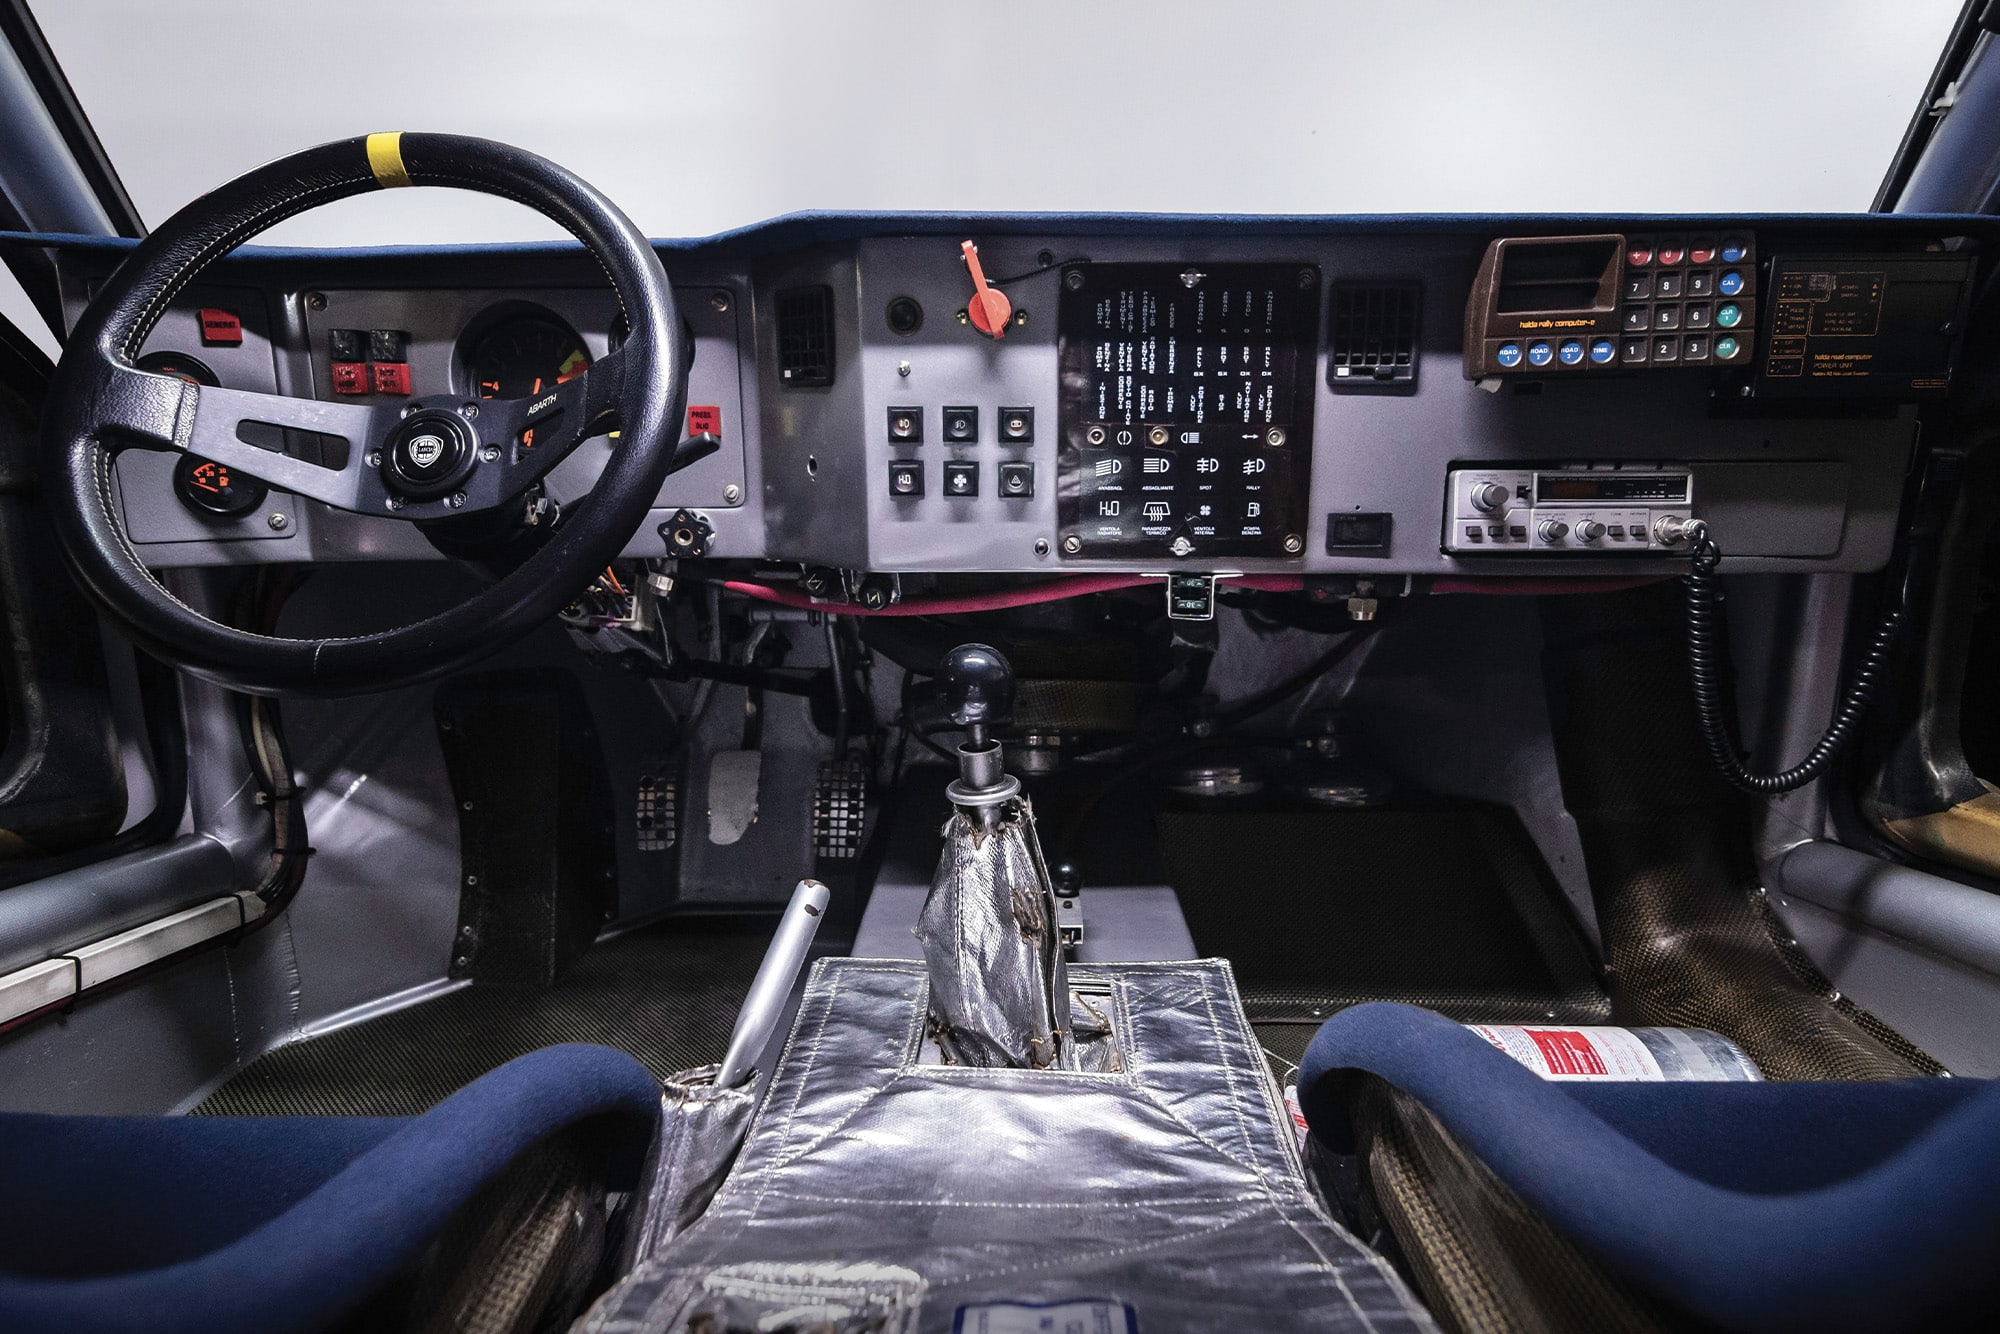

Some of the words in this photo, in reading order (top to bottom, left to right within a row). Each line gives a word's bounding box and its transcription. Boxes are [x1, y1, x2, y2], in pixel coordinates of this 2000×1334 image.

[1632, 283, 1639, 292] 7
[1663, 281, 1670, 291] 8
[1695, 279, 1702, 289] 9
[1630, 314, 1637, 323] 4
[1662, 313, 1669, 322] 5
[1692, 311, 1699, 320] 6
[1629, 346, 1635, 355] 1
[1661, 344, 1668, 354] 2
[1691, 343, 1698, 352] 3
[527, 393, 557, 416] ABARTH
